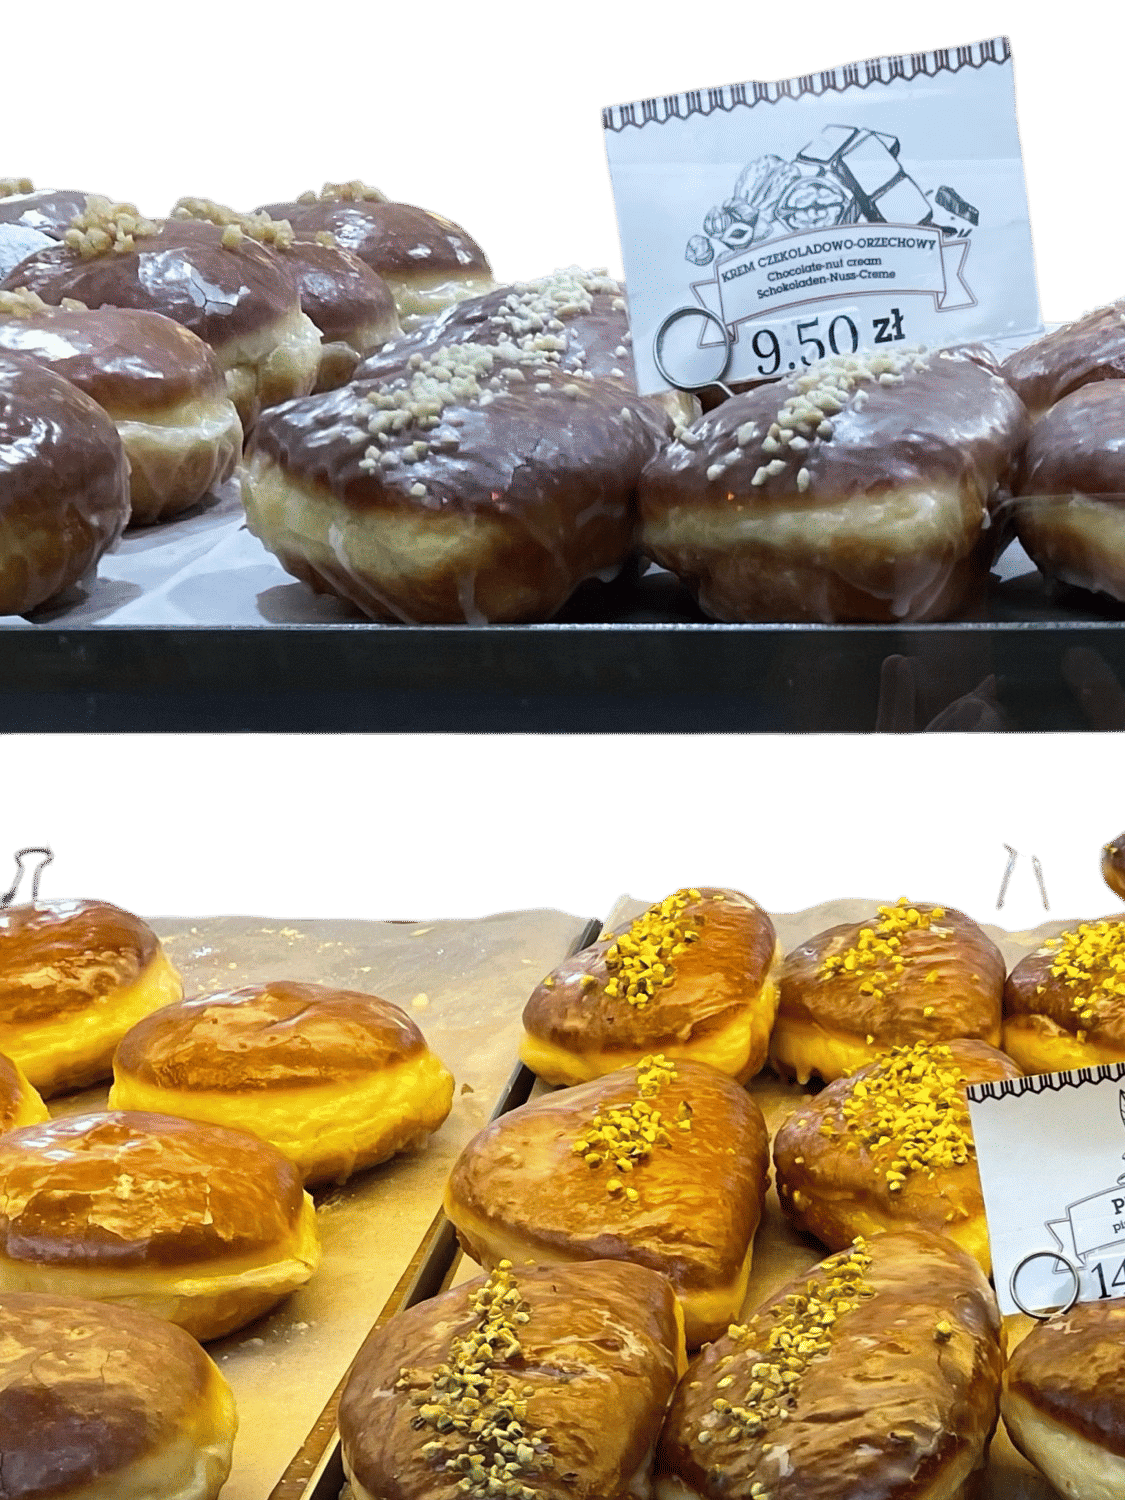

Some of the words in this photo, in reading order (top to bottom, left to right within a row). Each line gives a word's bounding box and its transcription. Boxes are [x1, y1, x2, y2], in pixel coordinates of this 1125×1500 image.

[721, 262, 756, 283] KREM
[758, 237, 936, 268] CZEKOLADOWO-ORZECHOWY
[767, 258, 843, 282] Chocolate-nut
[847, 257, 882, 267] cream
[757, 270, 896, 299] Schokoladen-Nuss-Creme
[752, 315, 859, 375] 9.50
[872, 308, 906, 344] zł
